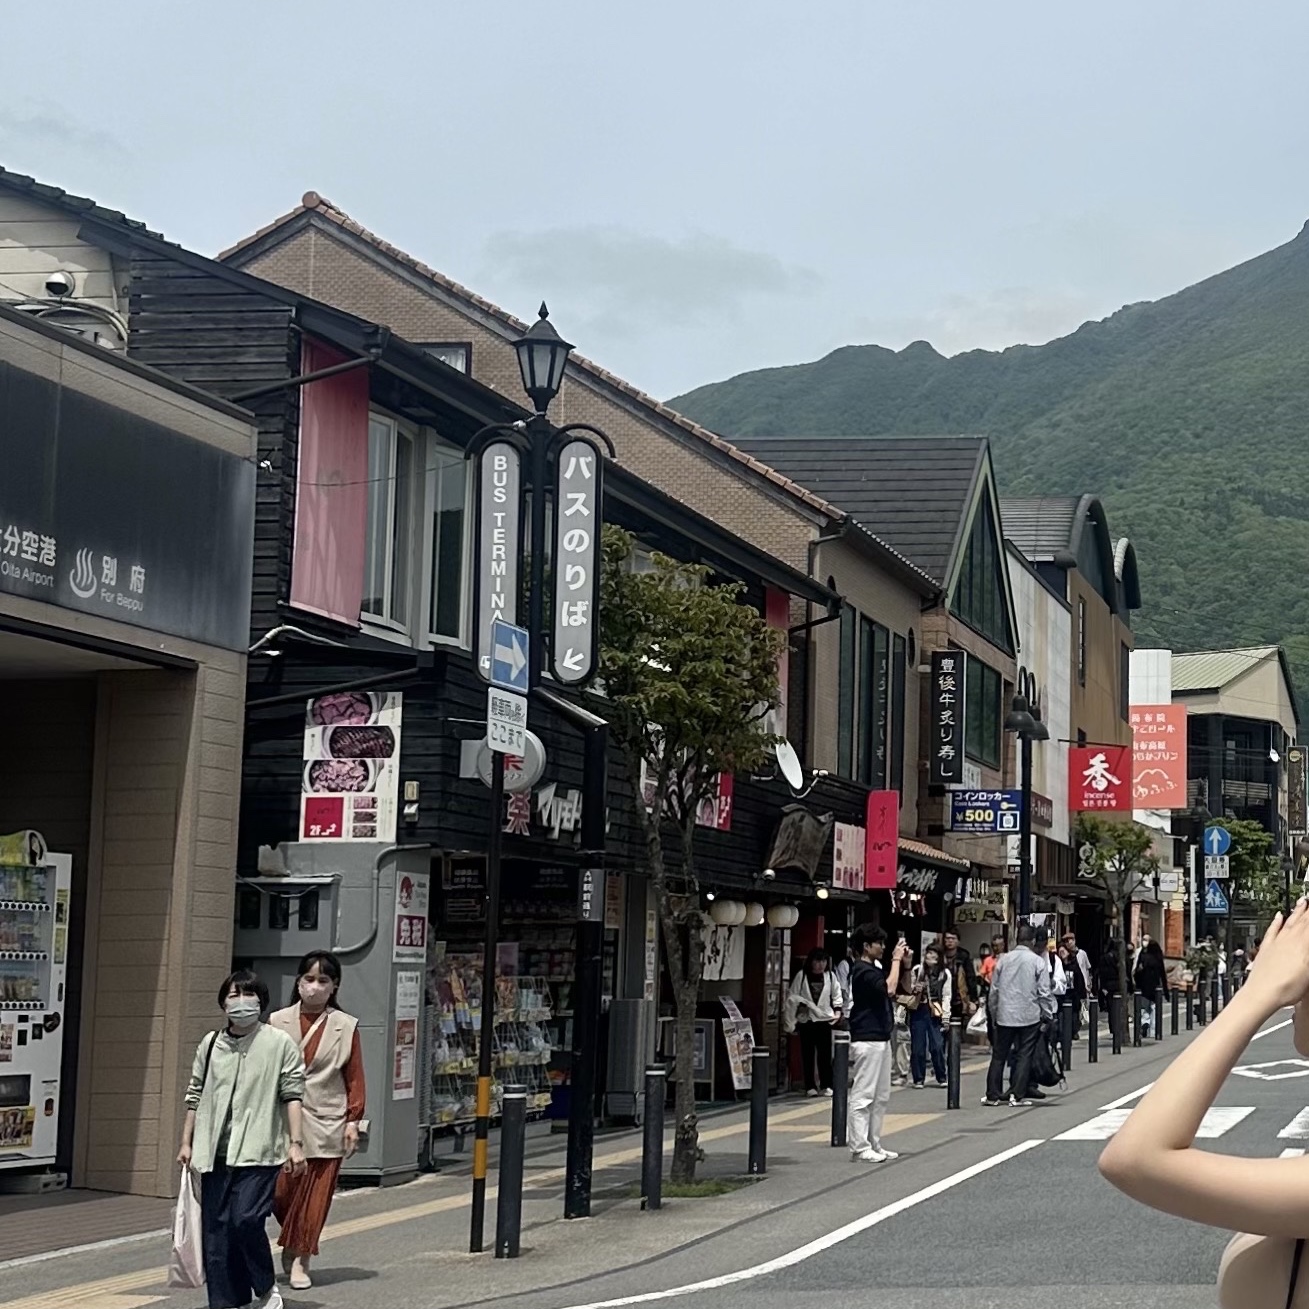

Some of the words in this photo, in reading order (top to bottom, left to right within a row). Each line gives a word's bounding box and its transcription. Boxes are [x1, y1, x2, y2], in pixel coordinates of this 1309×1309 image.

[493, 455, 508, 503] BUS
[0, 524, 57, 567] 分空港
[562, 456, 593, 627] バスのりば
[22, 566, 54, 587] Airport
[102, 555, 146, 594] 別府
[116, 592, 144, 612] Beppu
[491, 722, 523, 749] ここまで
[1082, 752, 1122, 791] 香
[954, 791, 1011, 801] コインロッカー
